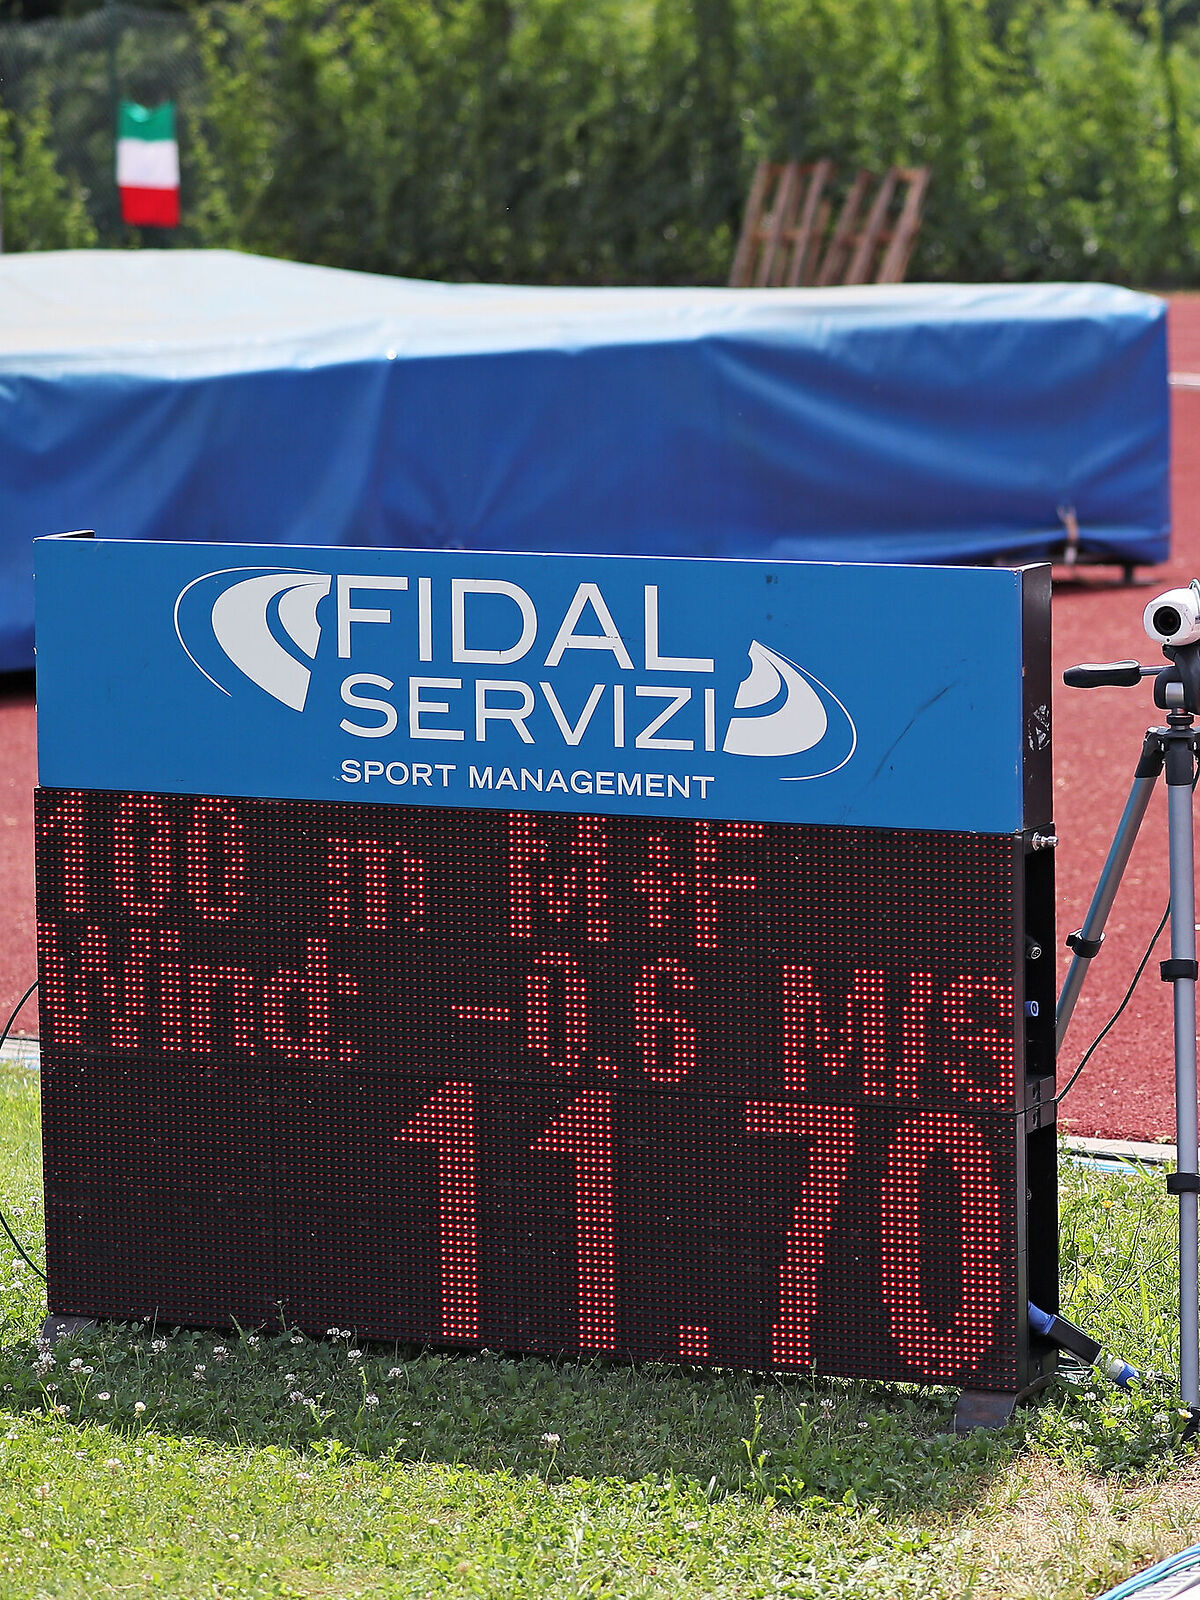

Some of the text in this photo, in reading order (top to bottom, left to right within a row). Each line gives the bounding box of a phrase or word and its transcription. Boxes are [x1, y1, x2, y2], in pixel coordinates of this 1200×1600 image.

[337, 575, 714, 673] FIDAL
[340, 672, 715, 752] SERVIZI
[341, 759, 715, 799] SPORT MANAGEMENT
[41, 790, 245, 922] 100
[394, 1081, 1000, 1376] 11.70
